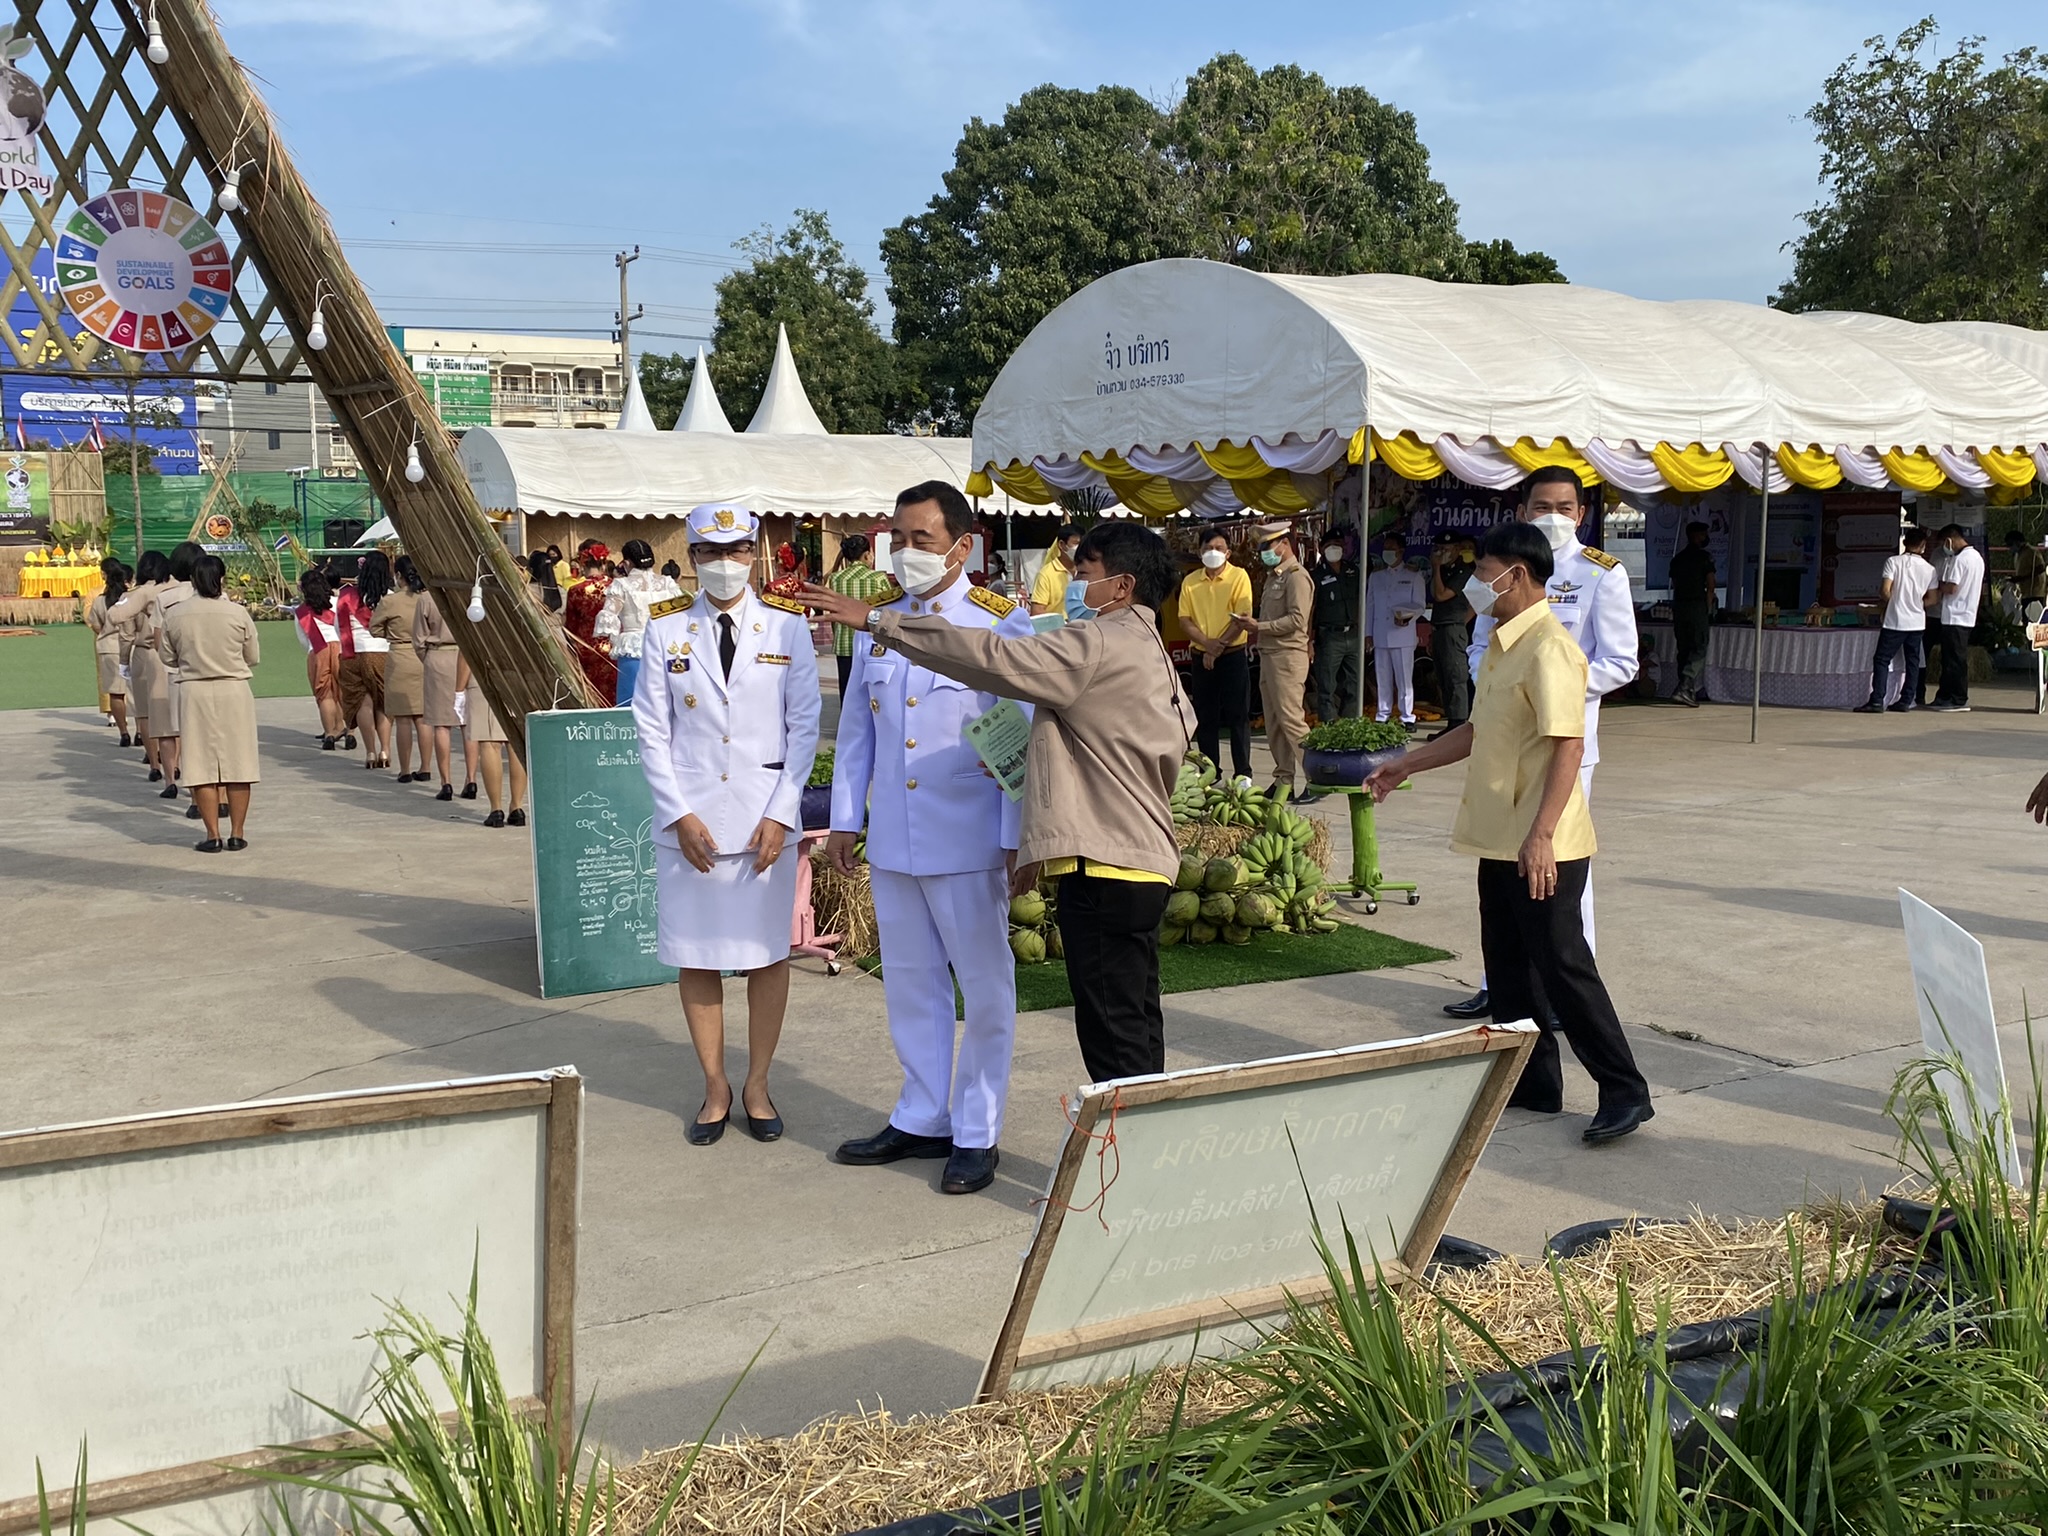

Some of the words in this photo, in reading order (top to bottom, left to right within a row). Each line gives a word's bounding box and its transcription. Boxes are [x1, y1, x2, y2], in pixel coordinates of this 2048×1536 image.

[0, 146, 37, 166] orld
[12, 168, 51, 196] Day
[116, 260, 174, 269] SUSTAINABLE
[116, 268, 174, 277] DEVELOPMENT
[117, 275, 175, 290] GOALS
[1128, 333, 1169, 366] บริการ
[1130, 372, 1185, 390] 034-579330
[1431, 497, 1516, 527] วันดินโล
